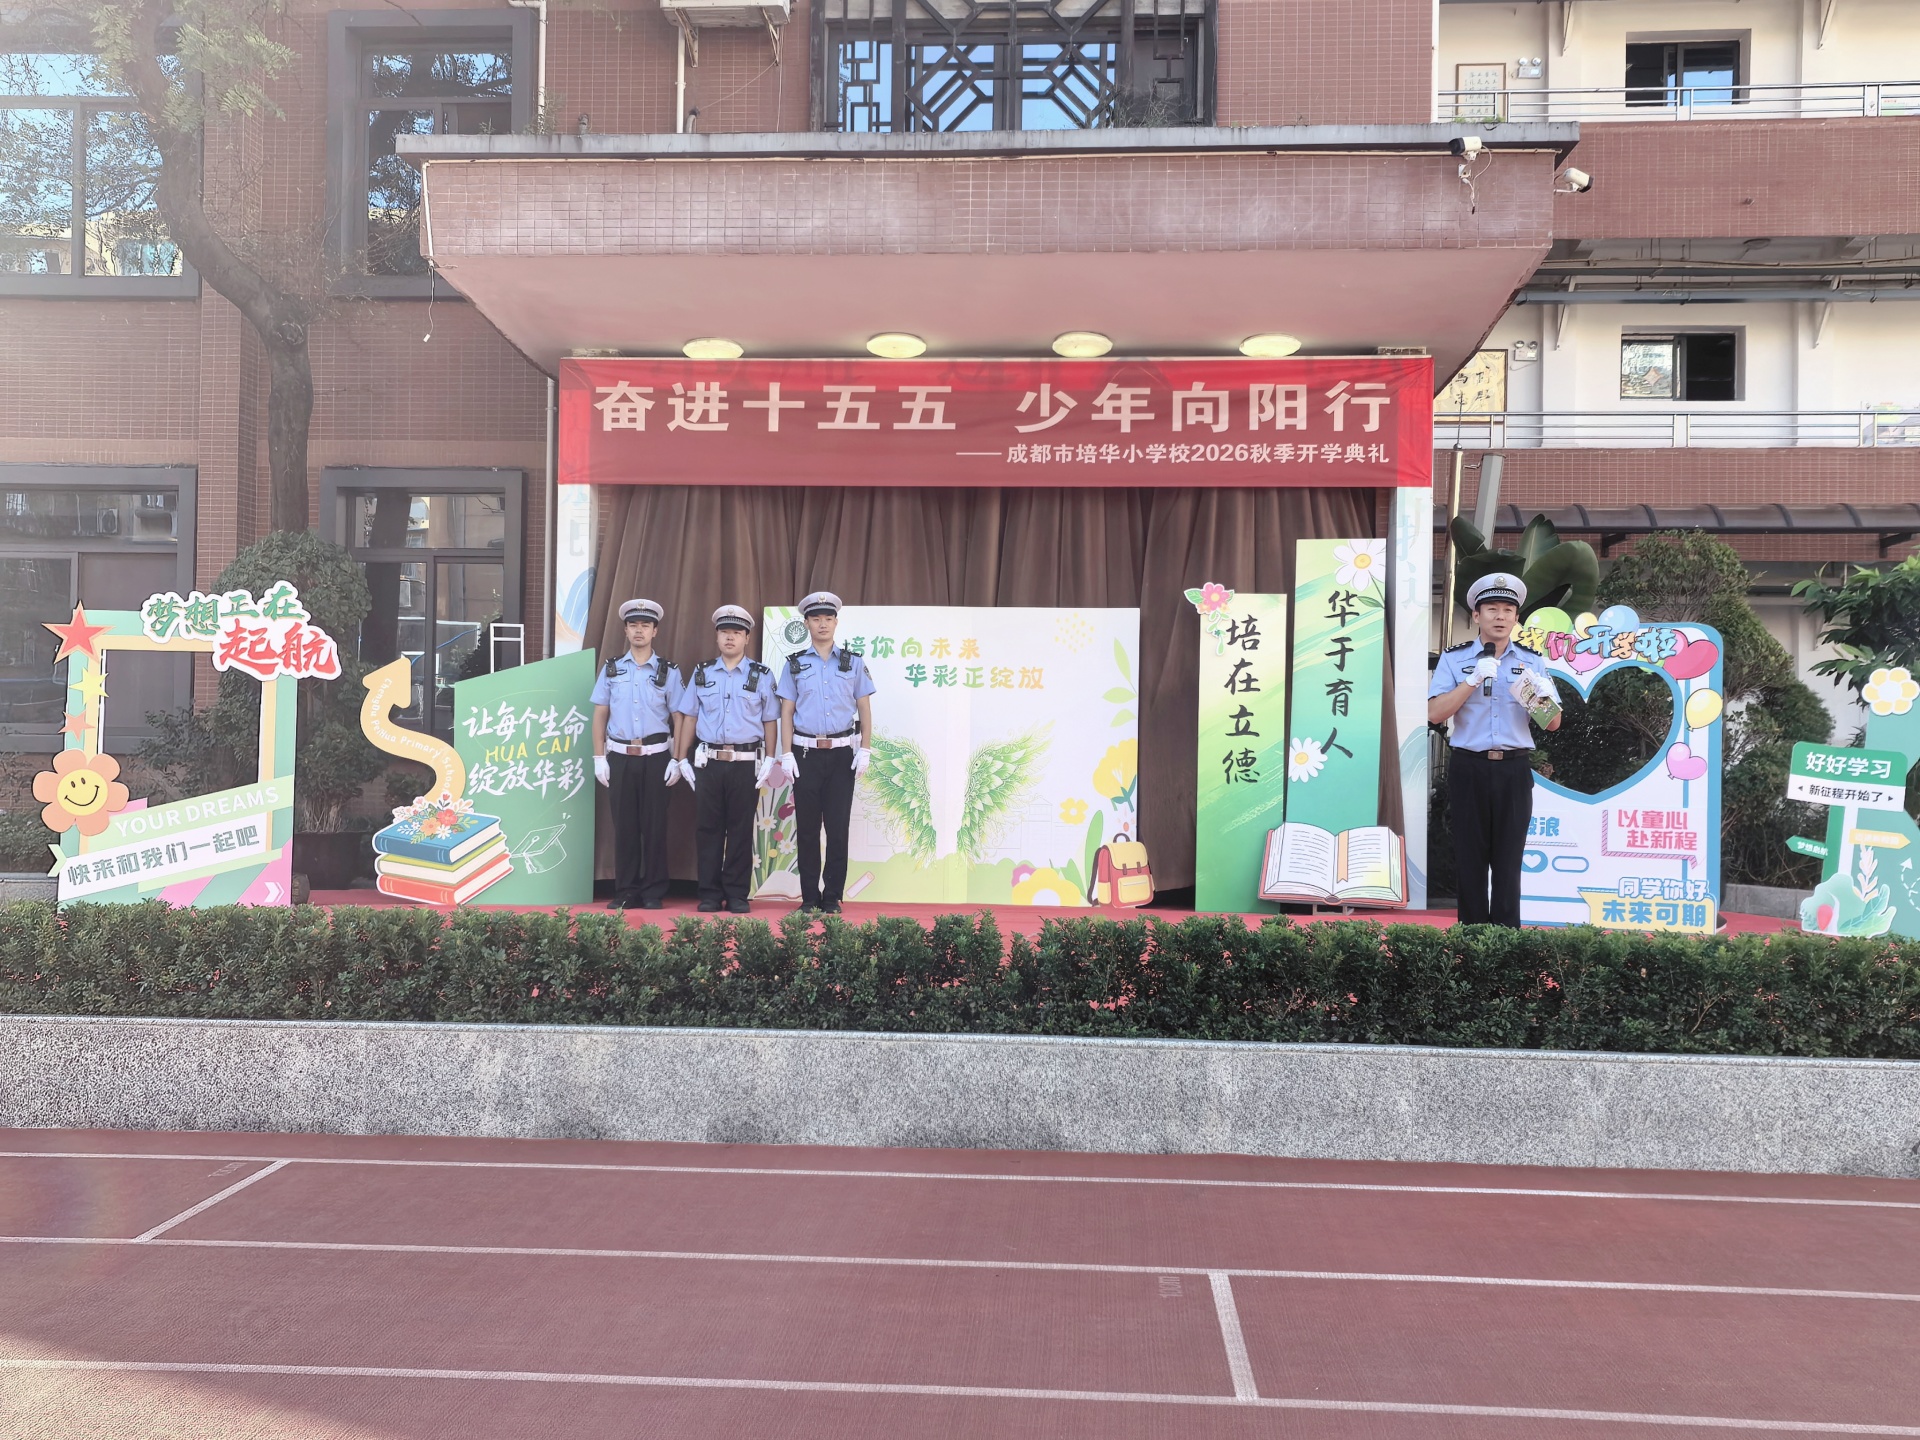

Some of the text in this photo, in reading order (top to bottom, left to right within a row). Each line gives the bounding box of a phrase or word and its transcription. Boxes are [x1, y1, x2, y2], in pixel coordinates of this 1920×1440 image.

[594, 380, 956, 432] 奋进十五五
[1015, 380, 1391, 433] 少年向阳行
[147, 585, 304, 638] 梦想正在
[219, 618, 337, 674] 起航
[1518, 625, 1677, 663] 我们开学啦
[904, 664, 1045, 690] 华彩正绽放
[1320, 590, 1360, 760] 华于育人
[1222, 614, 1261, 785] 培在立德
[462, 701, 590, 747] 让每个生命
[400, 735, 442, 759] Primary
[485, 736, 570, 764] HUA CAI
[1805, 751, 1892, 779] 好好学习
[468, 757, 585, 802] 绽放华彩
[1808, 784, 1883, 802] 新征程开始了
[114, 785, 280, 838] YOUR DREAMS
[1617, 808, 1688, 830] 以童心
[67, 825, 260, 886] 快来和我们一起吧
[1626, 829, 1698, 851] 赴新程
[1618, 877, 1709, 902] 同学你好
[1602, 900, 1706, 928] 未来可期
